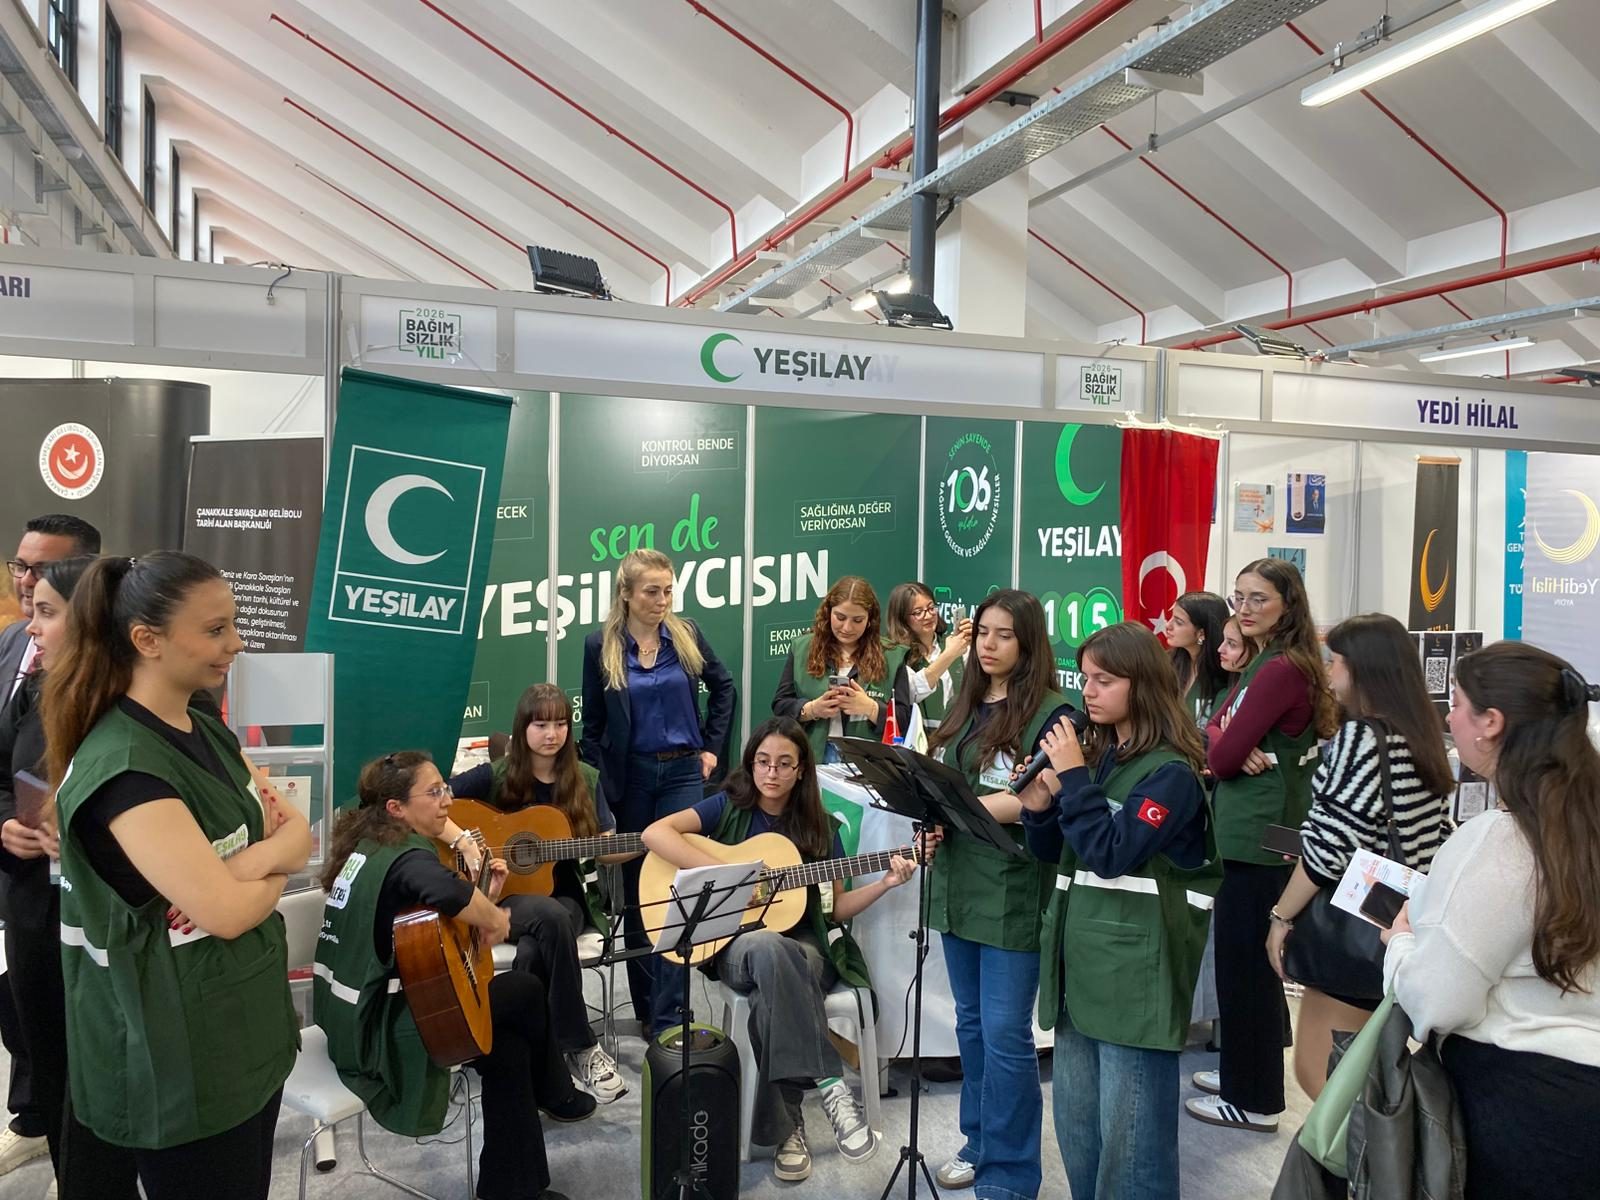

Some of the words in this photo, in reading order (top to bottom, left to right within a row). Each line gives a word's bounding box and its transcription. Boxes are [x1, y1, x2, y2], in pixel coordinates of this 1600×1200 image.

[415, 308, 445, 319] 2026
[406, 318, 454, 334] BAĞIM
[406, 332, 453, 347] SIZLIK
[416, 345, 444, 359] YILI
[1091, 363, 1111, 372] 2026
[1085, 372, 1117, 384] BAĞIM
[1085, 384, 1116, 395] SIZLIK
[1092, 395, 1110, 405] YILI
[1417, 396, 1459, 426] YEDİ
[1467, 398, 1519, 430] HİLAL
[641, 439, 695, 452] KONTROL
[697, 438, 734, 450] BENDE
[641, 453, 699, 467] DİYORSAN
[196, 508, 233, 518] ÇANAKKALE
[234, 508, 268, 519] SAVAŞLARI
[269, 508, 302, 518] GELİBOLU
[800, 503, 855, 518] SAĞLIĞINA
[858, 501, 891, 514] DEĞER
[196, 518, 214, 527] TARİHİ
[215, 520, 233, 528] ALAN
[234, 519, 271, 531] BAŞKANLIĞI
[590, 523, 655, 561] sen
[670, 493, 719, 552] de
[800, 517, 866, 531] VERİYORSAN
[964, 548, 973, 558] VE
[234, 582, 264, 592] Çanakkale
